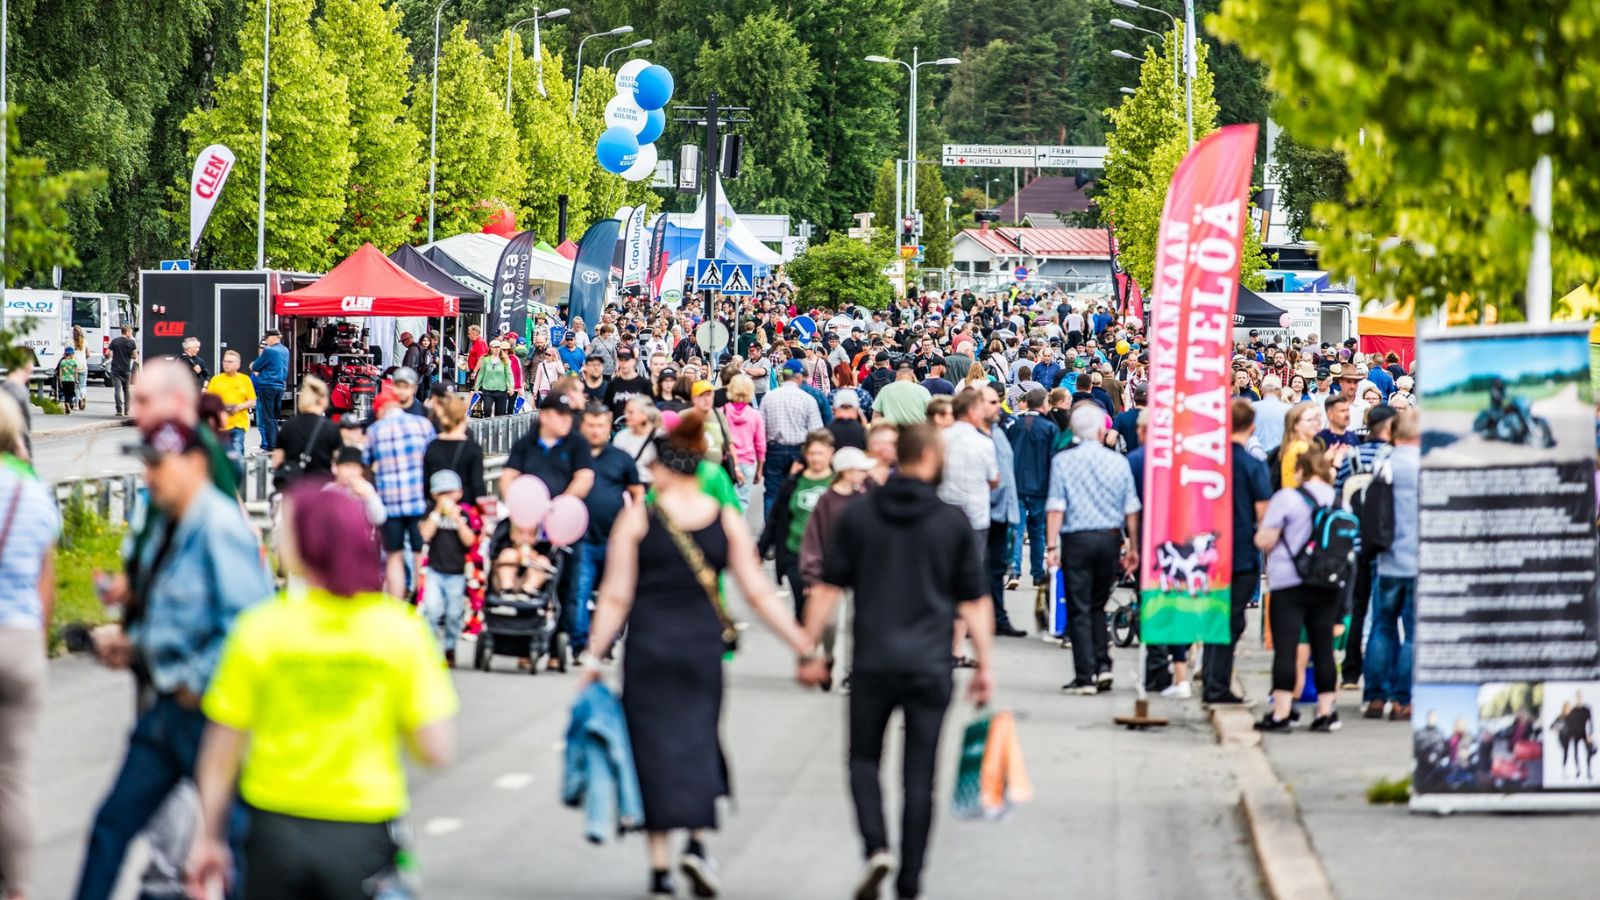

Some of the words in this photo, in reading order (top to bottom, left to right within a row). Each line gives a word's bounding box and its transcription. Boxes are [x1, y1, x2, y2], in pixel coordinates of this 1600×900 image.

[613, 113, 638, 121] KOLMIO
[616, 107, 637, 115] MAITO
[1052, 147, 1074, 155] FRAMI
[195, 155, 226, 200] CLEN
[629, 210, 643, 271] Granlunds
[341, 296, 374, 311] CLEN
[153, 321, 185, 335] CLEN
[1151, 220, 1190, 470] LIISANKANKAAN
[1174, 198, 1241, 500] JÄÄTELÖÄ
